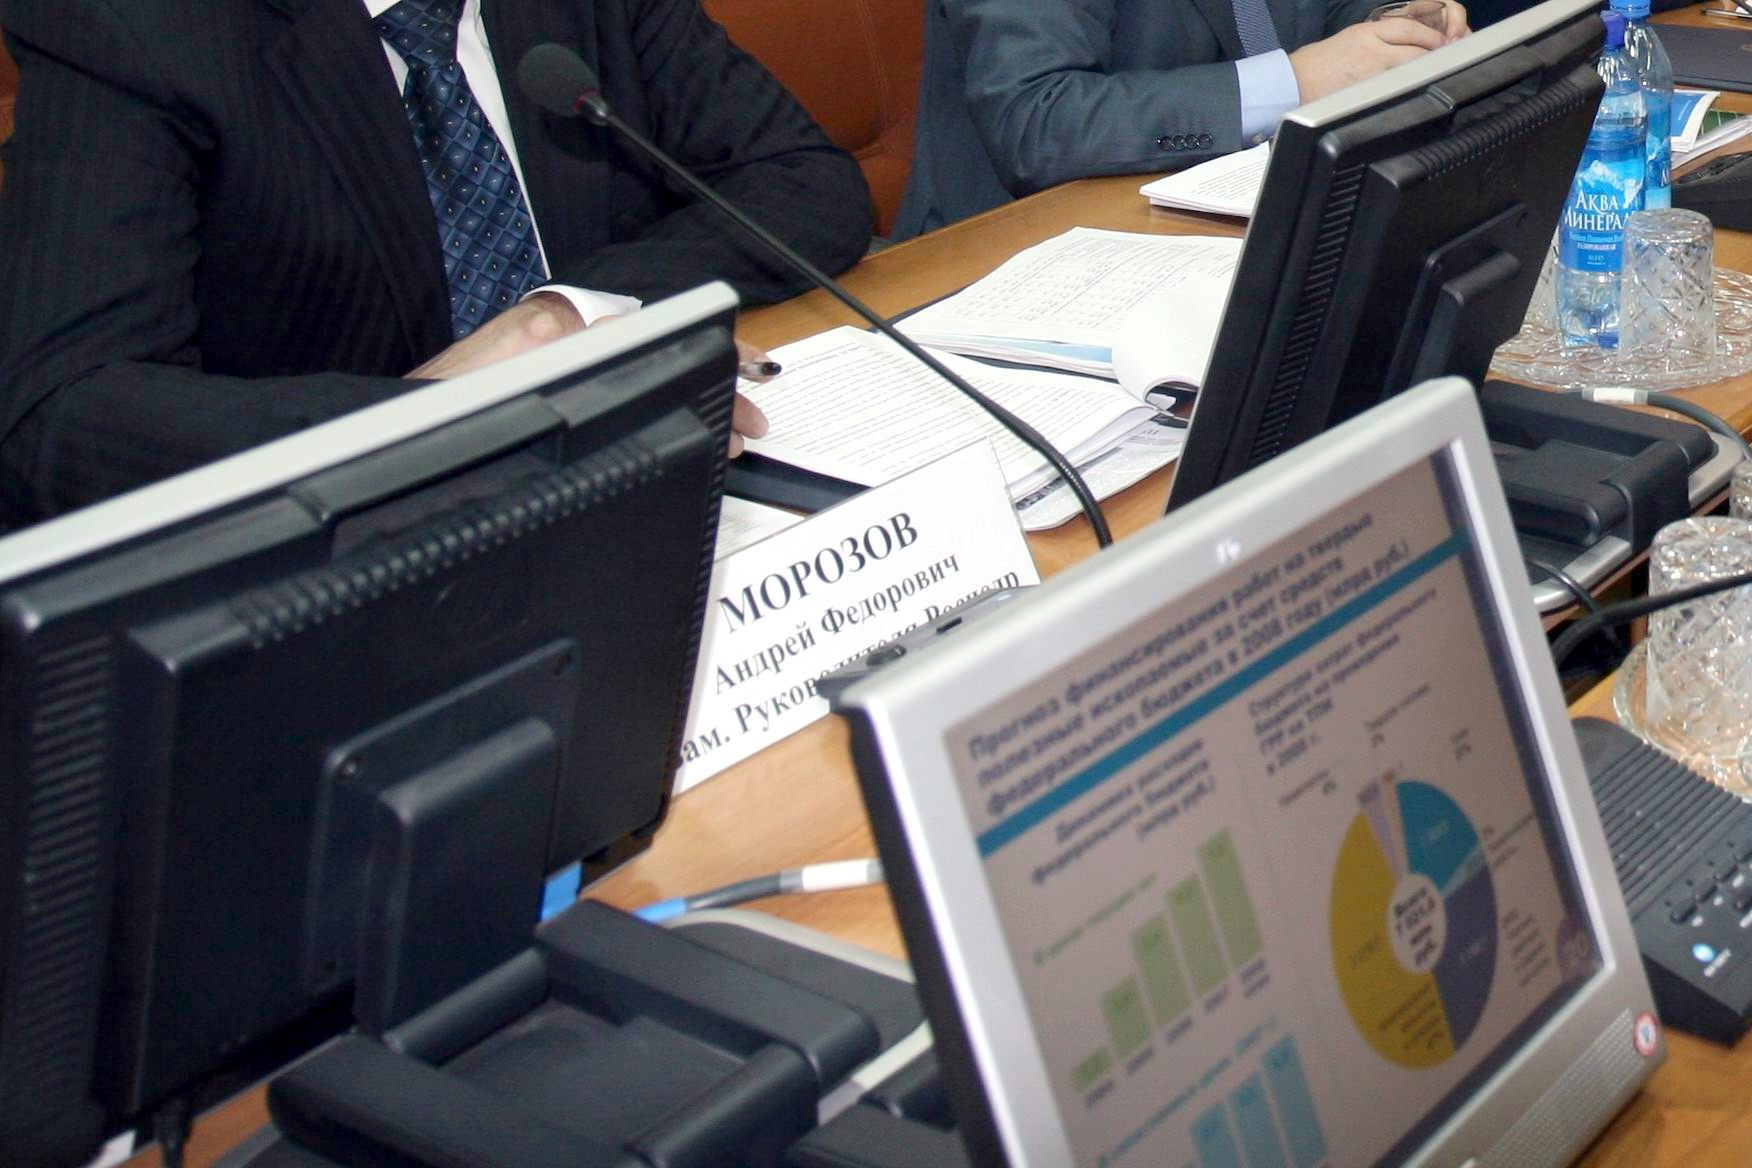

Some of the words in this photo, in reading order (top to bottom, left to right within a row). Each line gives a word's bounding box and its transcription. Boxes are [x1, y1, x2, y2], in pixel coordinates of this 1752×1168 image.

[1575, 188, 1619, 214] АКВА
[716, 512, 918, 634] МОРОЗОВ
[715, 621, 817, 696] Андрей
[820, 553, 961, 634] Федорович
[679, 727, 731, 765] ам.
